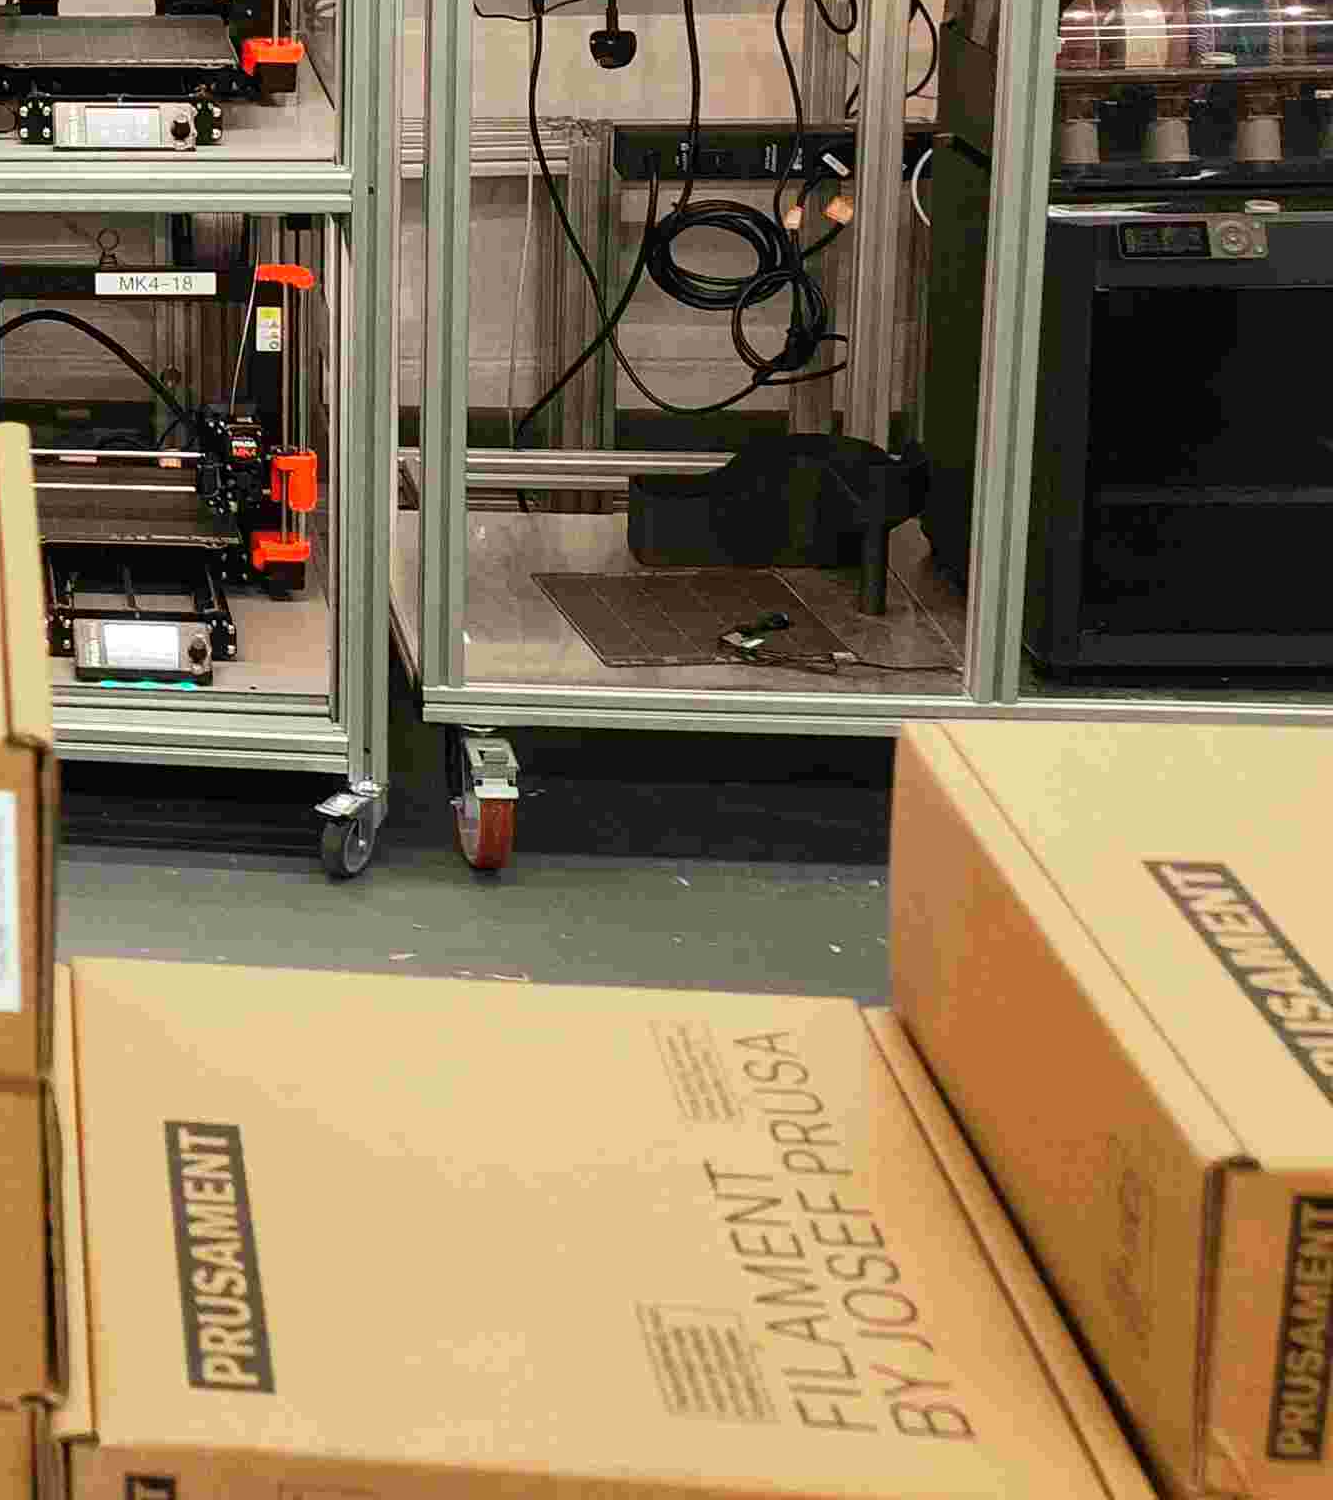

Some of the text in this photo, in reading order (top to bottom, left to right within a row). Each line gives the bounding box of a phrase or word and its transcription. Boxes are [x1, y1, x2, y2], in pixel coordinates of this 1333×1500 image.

[118, 273, 194, 293] MK4-18
[173, 1124, 265, 1390] PRUSAMENT
[703, 1159, 879, 1432] FILAMENT
[732, 1030, 976, 1440] BY JOSEF PRUSA
